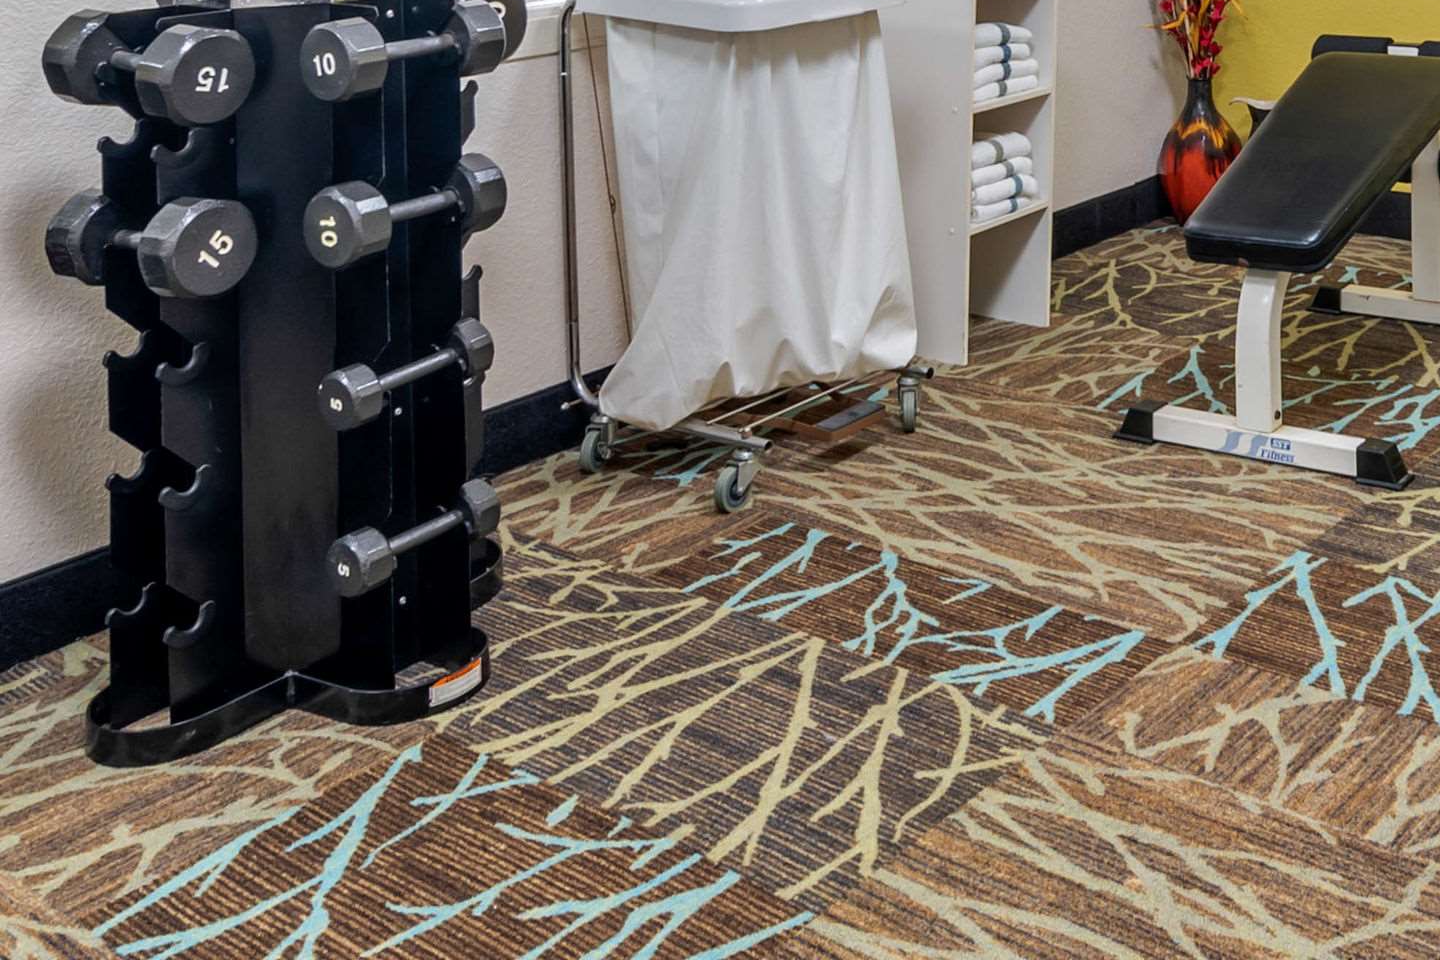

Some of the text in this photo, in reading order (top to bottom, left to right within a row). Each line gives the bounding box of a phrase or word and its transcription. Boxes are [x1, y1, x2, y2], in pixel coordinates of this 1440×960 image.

[312, 52, 336, 77] 10
[195, 66, 229, 93] 15
[319, 216, 338, 248] 10
[198, 229, 234, 268] 15
[330, 397, 343, 412] 5
[1261, 447, 1295, 463] Fitness
[337, 562, 350, 577] 5
